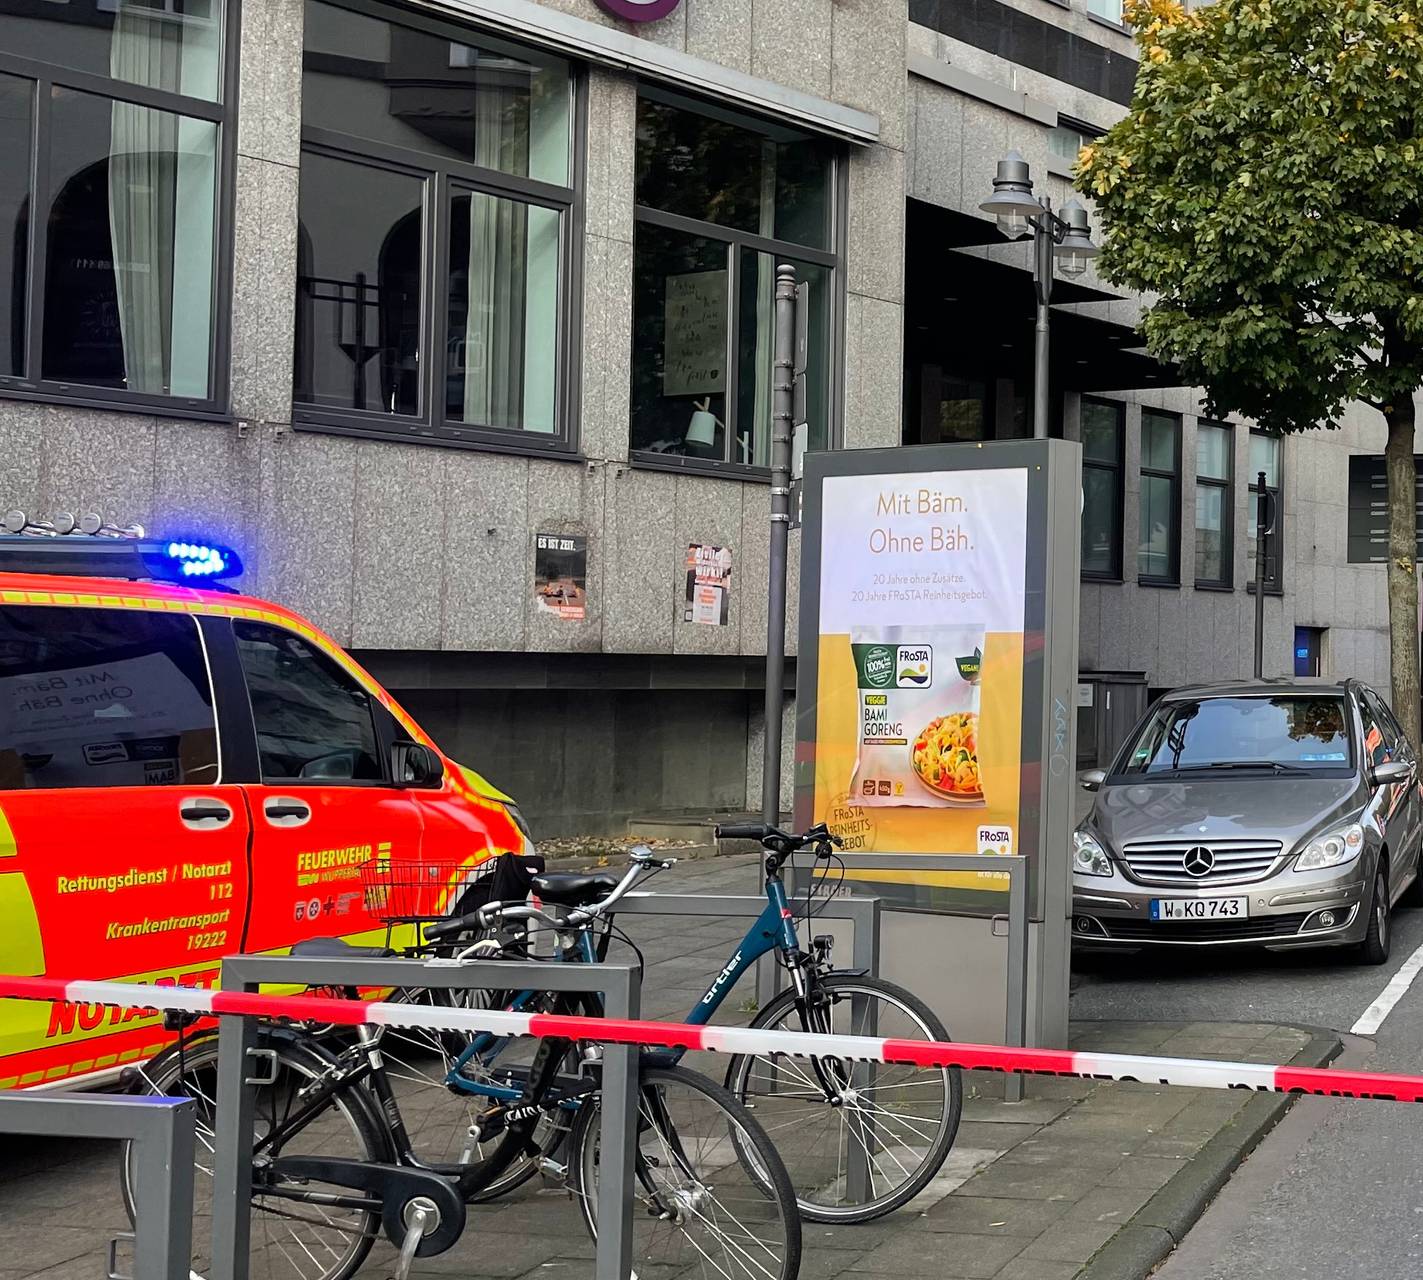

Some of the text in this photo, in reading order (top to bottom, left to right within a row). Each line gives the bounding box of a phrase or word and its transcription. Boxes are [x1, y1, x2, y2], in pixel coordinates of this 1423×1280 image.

[876, 489, 968, 517] Mit Bäm.
[537, 537, 576, 551] ES IST ZEIT.
[869, 524, 974, 554] Ohne Bäh.
[873, 574, 885, 585] 20
[886, 573, 908, 585] Jahre
[909, 573, 931, 584] ohne
[852, 590, 865, 602] 20
[865, 591, 887, 602] Jahre
[899, 650, 929, 662] FRoSTA
[864, 708, 888, 721] BAMI
[864, 722, 903, 736] GORENG
[833, 806, 865, 821] FRoSTA
[979, 830, 1010, 842] FRoSTA
[297, 845, 372, 871] FEUERWEHR
[57, 868, 168, 894] Rettungsdienst
[182, 861, 233, 880] Notarzt
[210, 883, 233, 901] 112
[1164, 900, 1239, 917] W KQ 743
[106, 909, 230, 940] Krankentransport
[187, 930, 227, 951] 19222
[702, 950, 742, 1004] ortler
